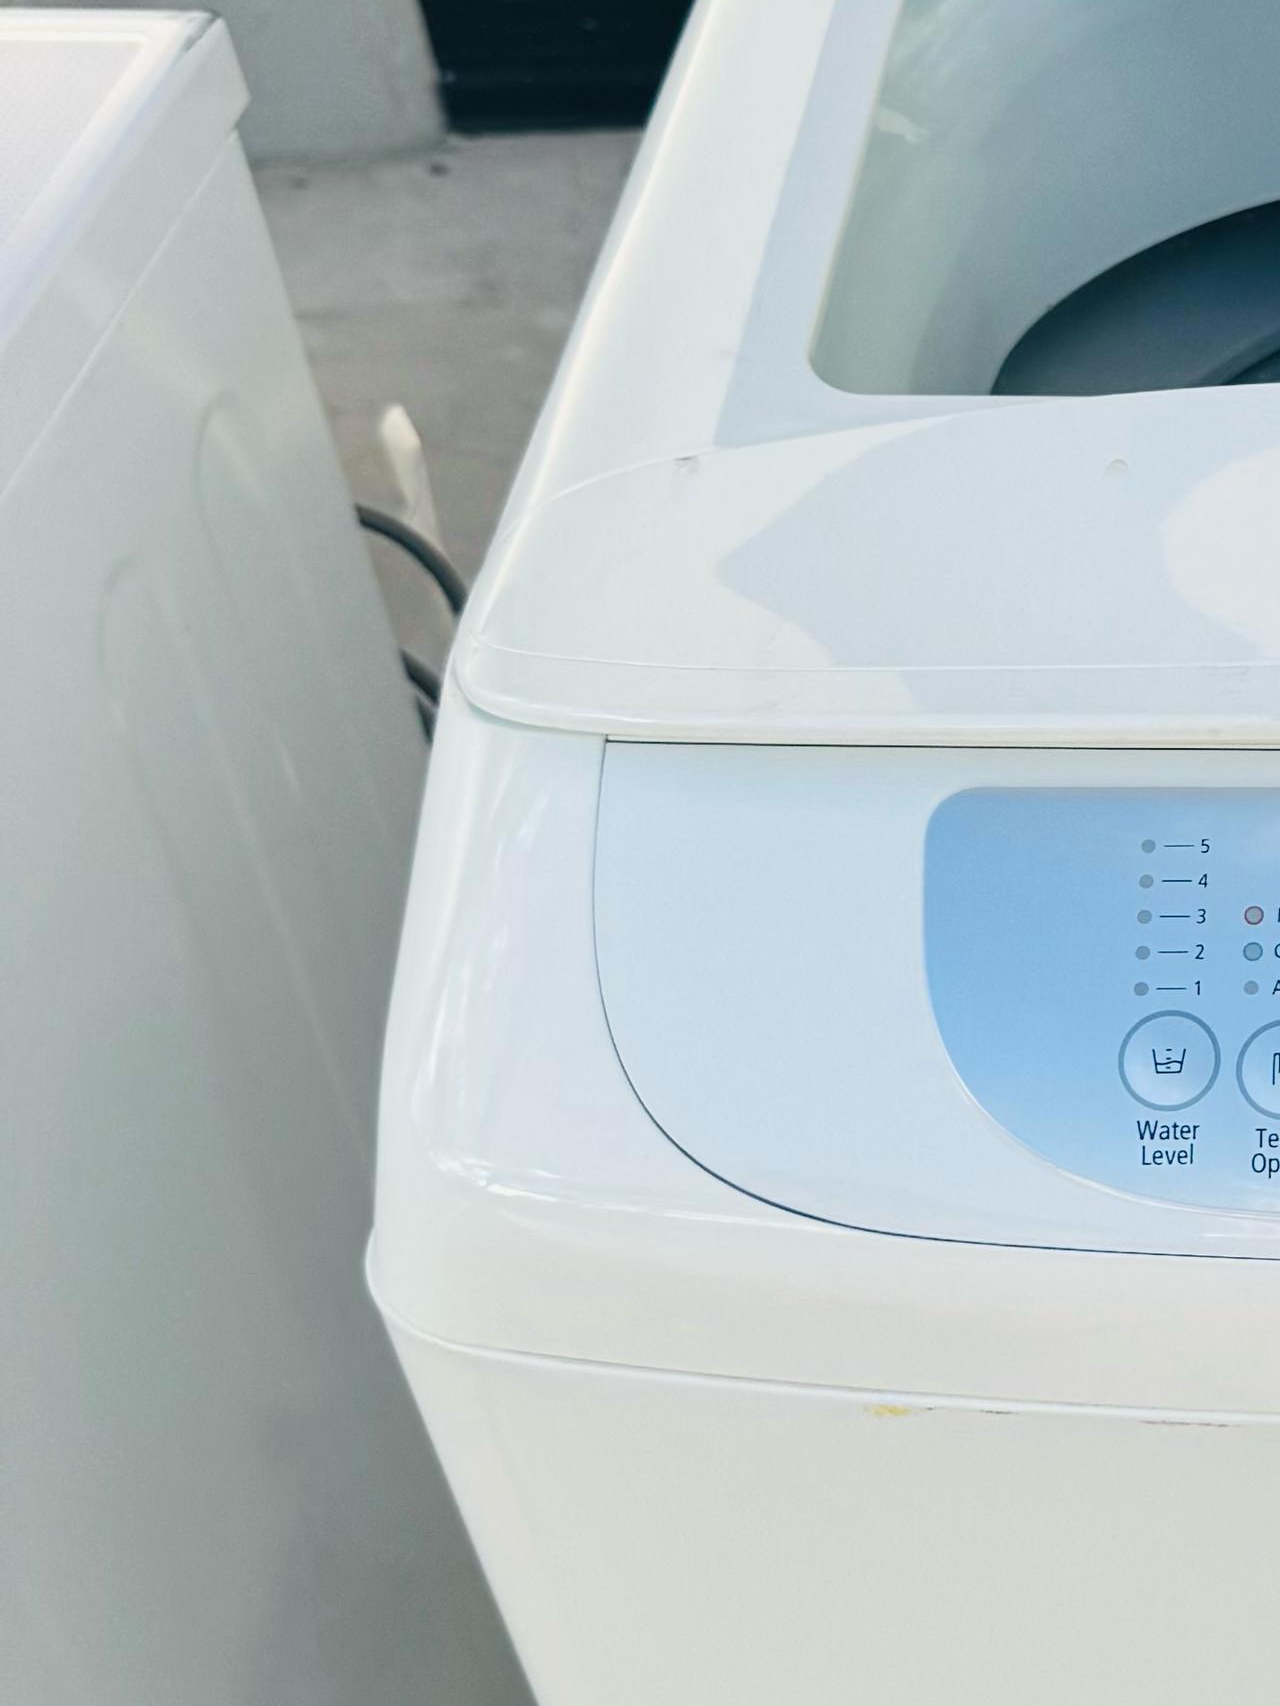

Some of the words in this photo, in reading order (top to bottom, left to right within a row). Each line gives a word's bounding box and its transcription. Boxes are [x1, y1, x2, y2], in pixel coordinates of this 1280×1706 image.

[1200, 838, 1210, 854] 5
[1197, 873, 1208, 888] 4
[1196, 908, 1207, 925] 3
[1194, 943, 1205, 960] 2
[1194, 980, 1201, 996] 1
[1136, 1120, 1200, 1141] Water
[1141, 1144, 1194, 1166] Level
